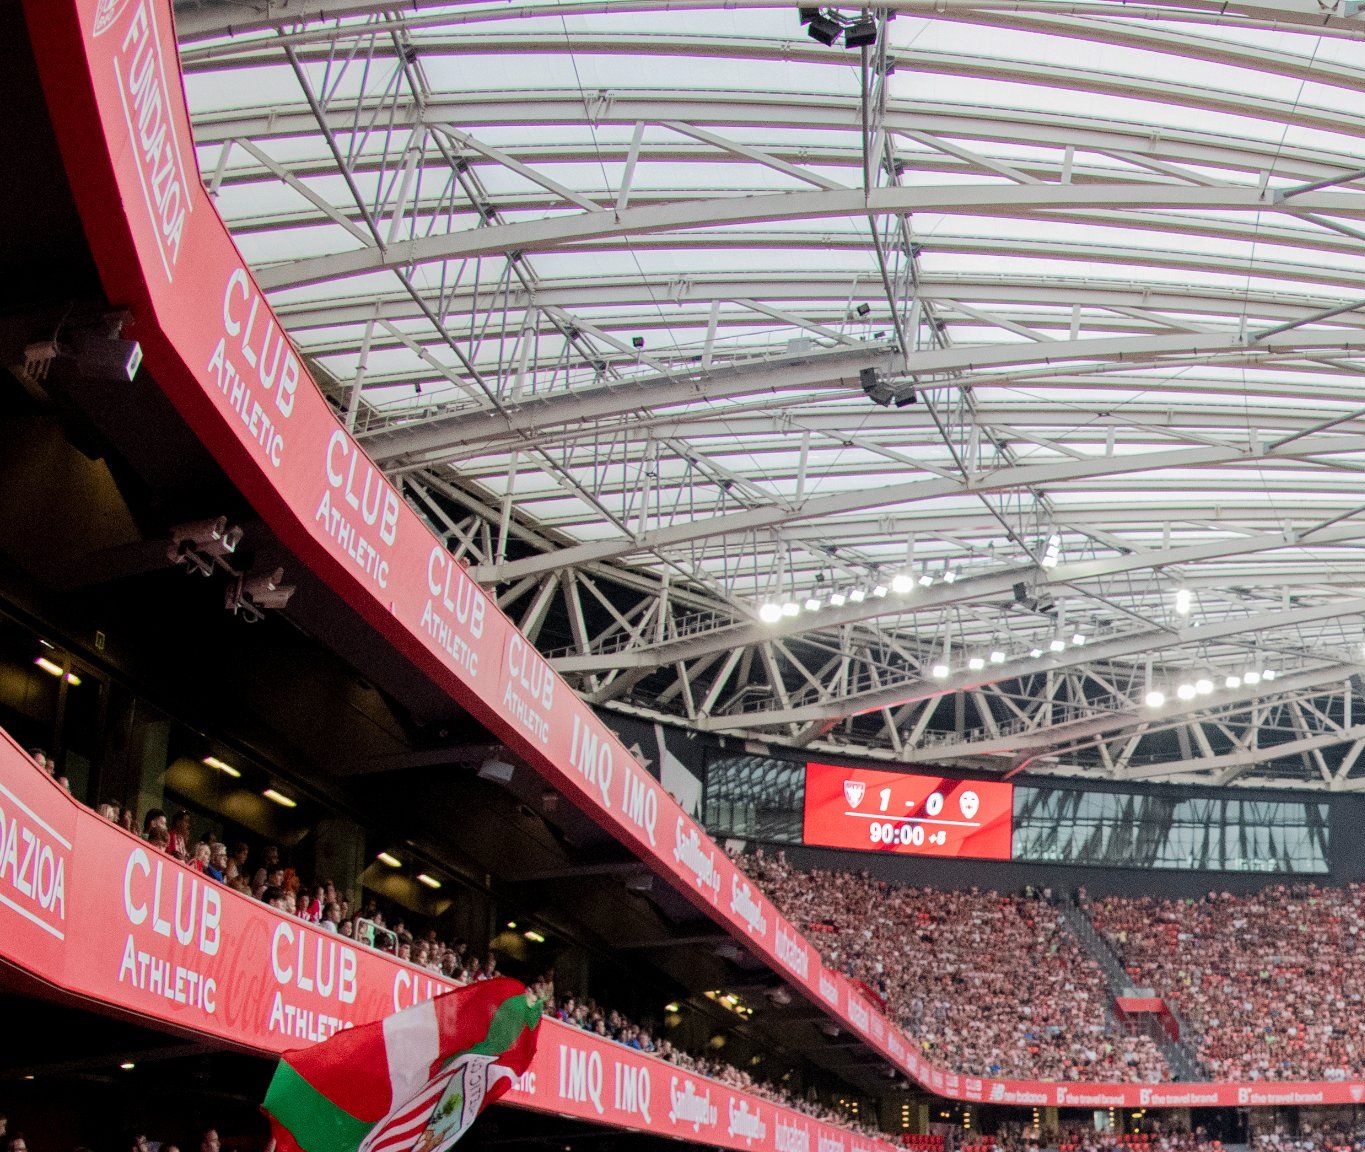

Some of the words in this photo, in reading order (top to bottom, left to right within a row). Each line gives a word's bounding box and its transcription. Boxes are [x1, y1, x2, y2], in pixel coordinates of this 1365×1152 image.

[122, 0, 186, 266] FUNDAZIOA
[224, 268, 300, 418] CLUB
[326, 429, 399, 546] CLUB
[428, 546, 486, 640] CLUB
[509, 633, 554, 709] CLUB
[569, 714, 613, 809] IMQ
[880, 788, 891, 811] 1
[926, 792, 944, 816] 0
[622, 766, 658, 847] IMQ
[870, 822, 925, 846] 90:00
[124, 847, 222, 956] CLUB
[272, 921, 358, 1004] CLUB
[559, 1045, 604, 1114] IMQ
[615, 1062, 650, 1124] IMQ
